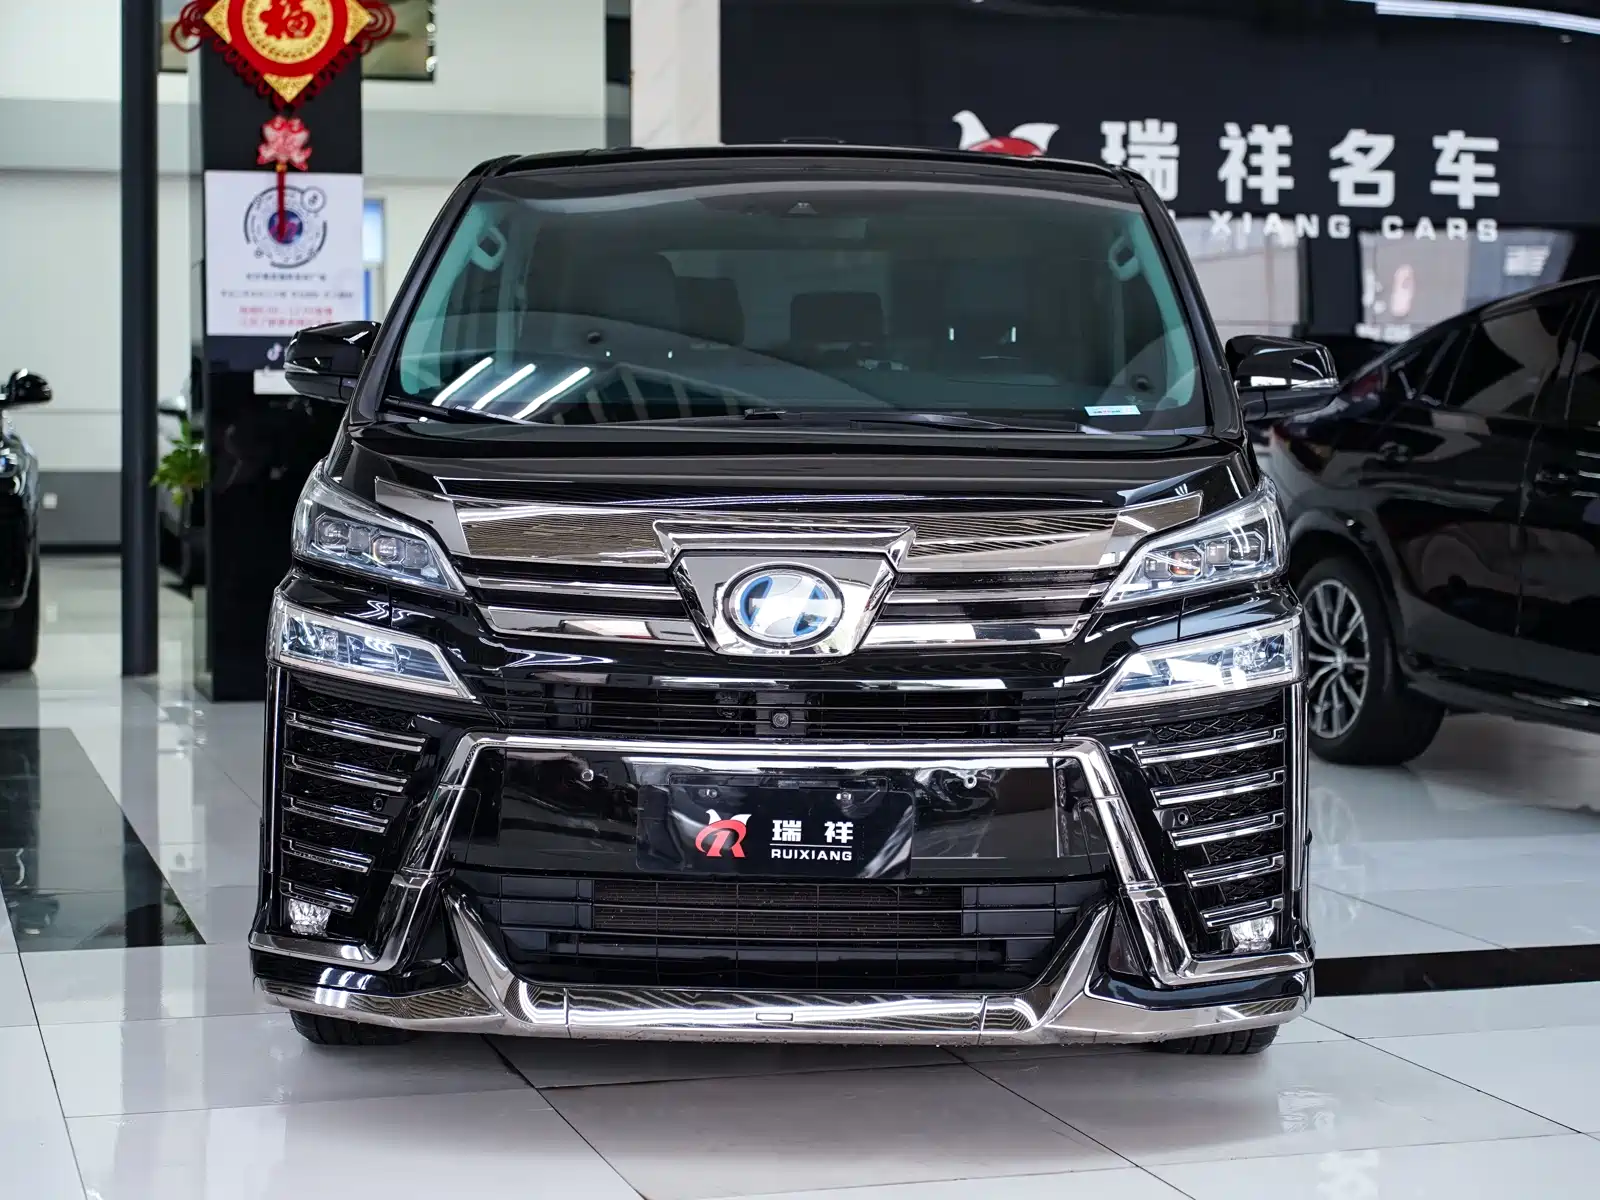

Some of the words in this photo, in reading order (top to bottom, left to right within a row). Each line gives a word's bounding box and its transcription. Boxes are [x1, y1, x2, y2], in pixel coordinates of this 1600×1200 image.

[1101, 119, 1500, 209] 瑞祥名车
[1209, 210, 1351, 239] XIANG
[1382, 216, 1499, 242] CARS
[772, 820, 853, 843] 瑞祥
[771, 849, 852, 861] RUIXIANG
